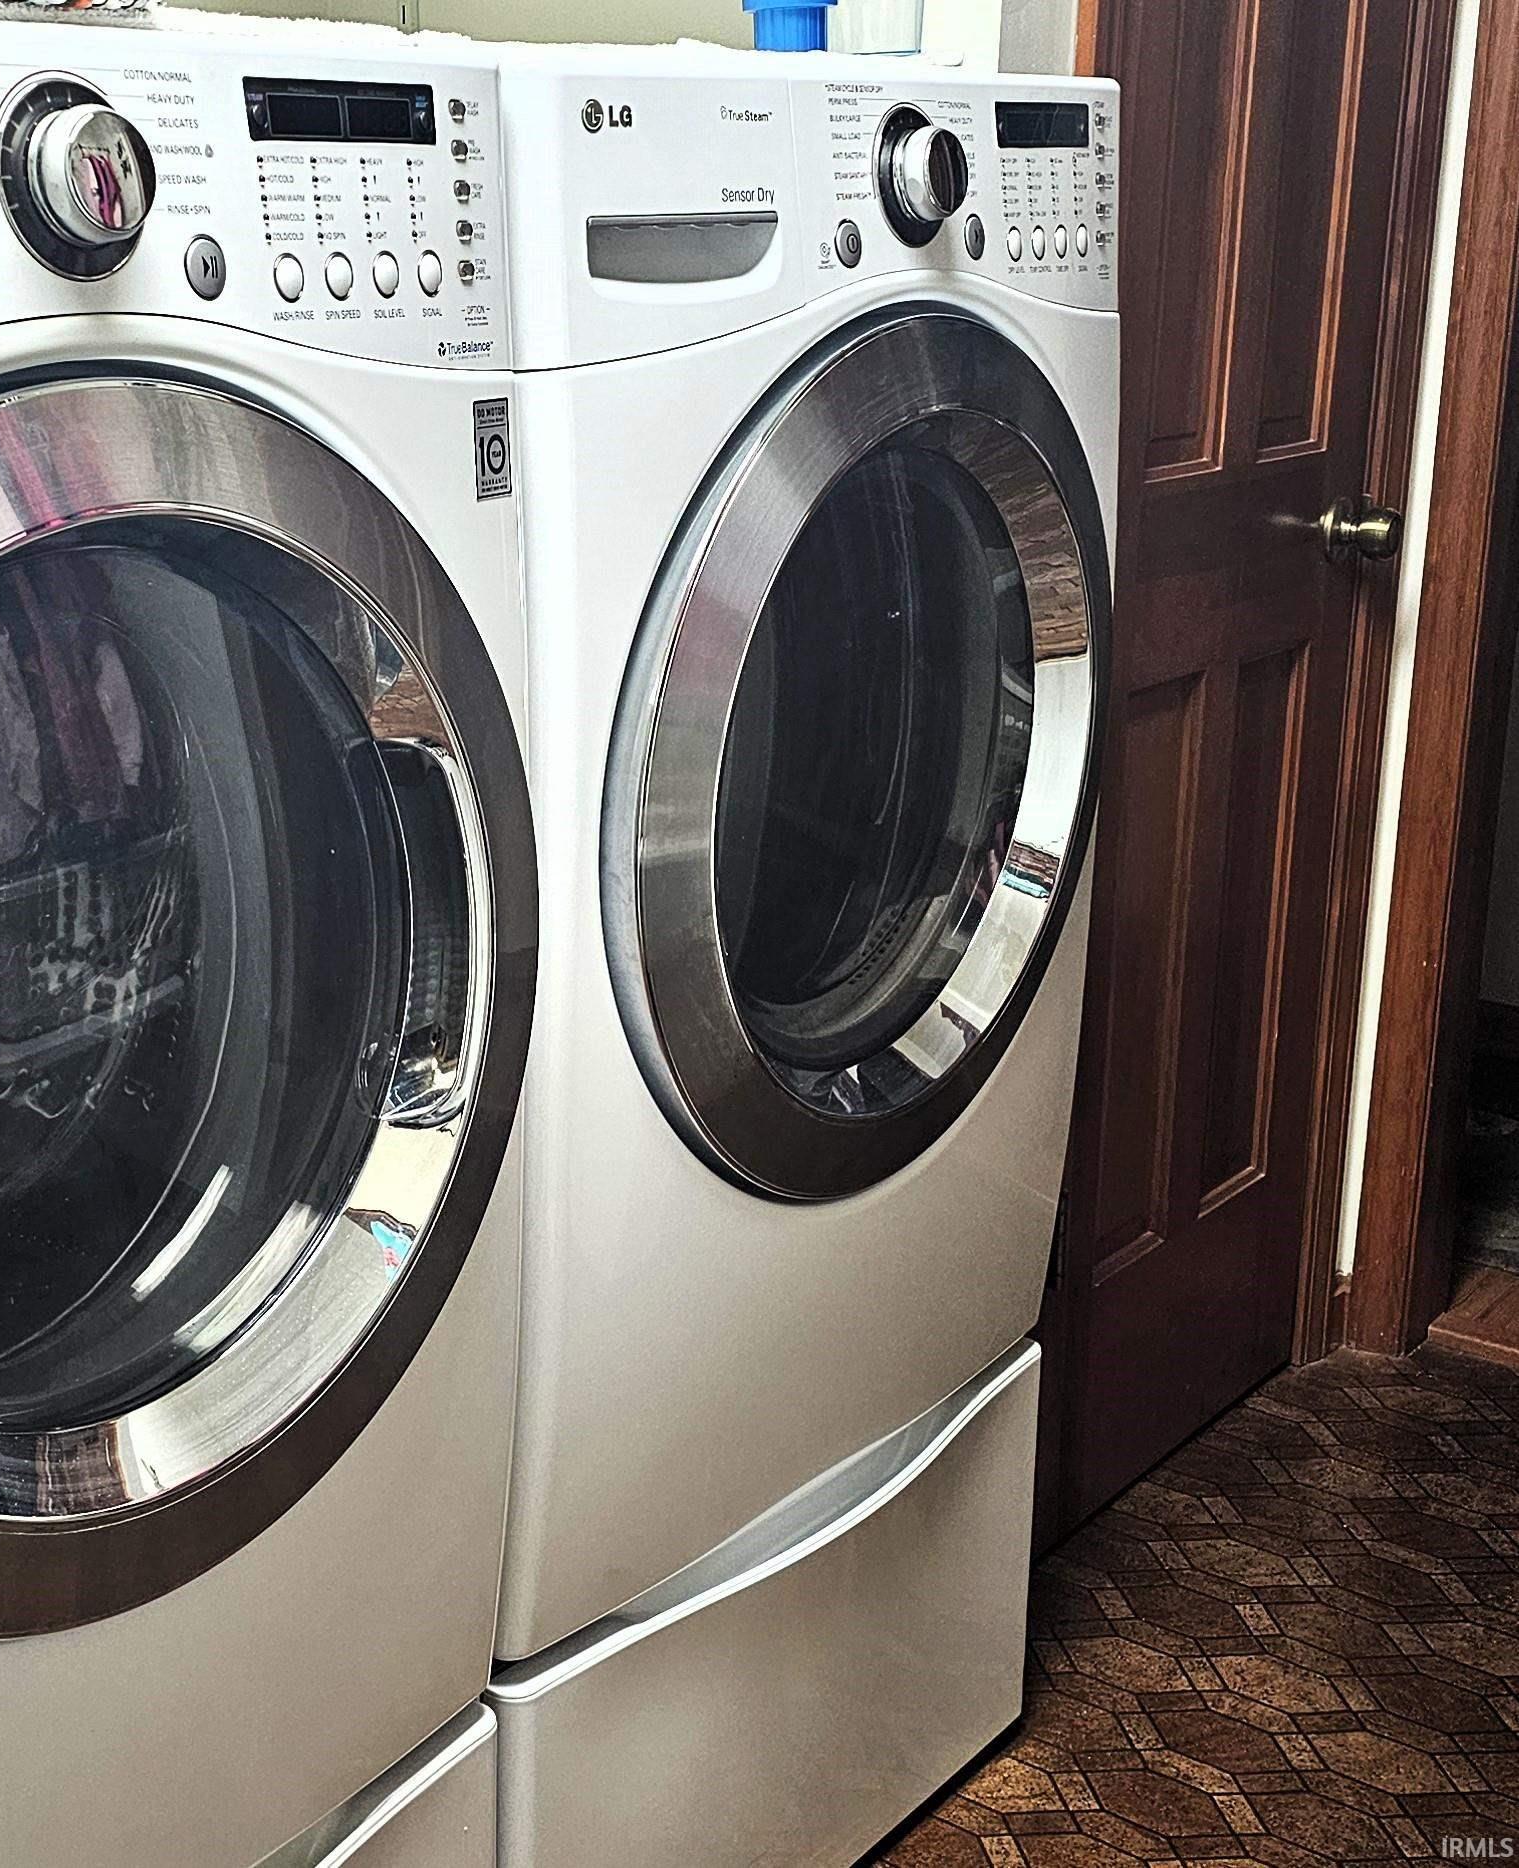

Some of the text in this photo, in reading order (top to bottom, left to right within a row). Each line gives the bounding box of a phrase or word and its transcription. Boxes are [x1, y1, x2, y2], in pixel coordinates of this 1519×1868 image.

[158, 117, 199, 129] DELICATES
[608, 105, 633, 128] LG
[721, 186, 776, 205] Sensor Dry
[479, 433, 506, 478] 10
